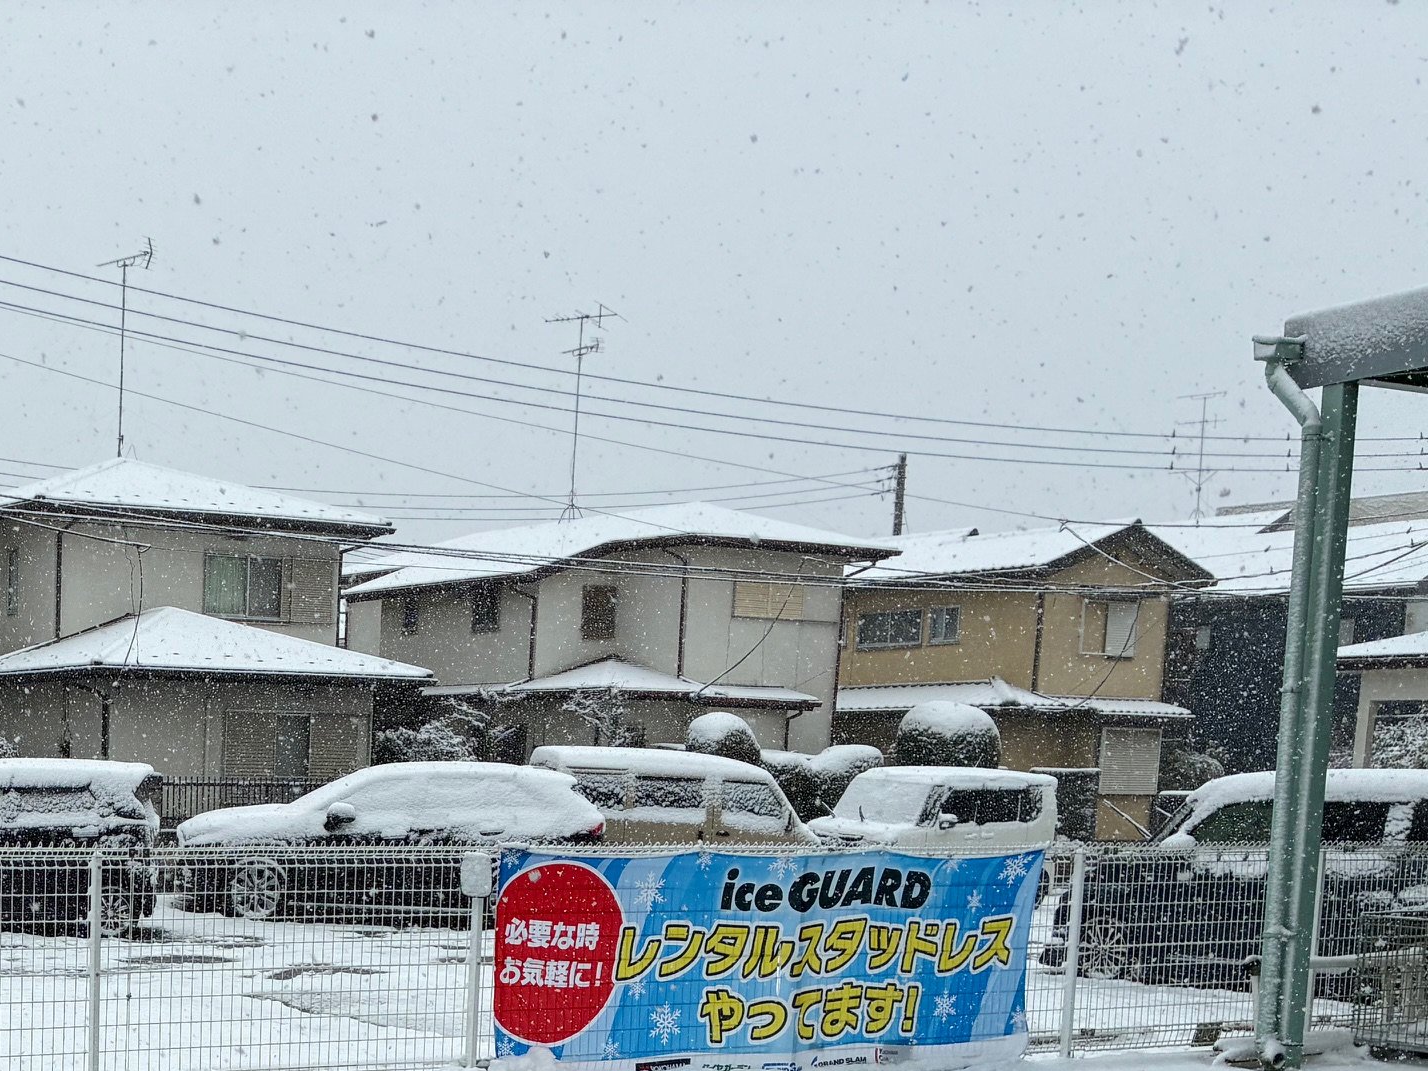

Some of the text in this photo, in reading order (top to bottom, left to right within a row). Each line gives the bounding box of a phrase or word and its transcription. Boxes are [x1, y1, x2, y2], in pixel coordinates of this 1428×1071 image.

[504, 917, 601, 951] 必要な時
[614, 917, 1014, 982] レンタルスタッドレス
[499, 956, 603, 988] お気軽に!
[700, 981, 919, 1043] やってます!
